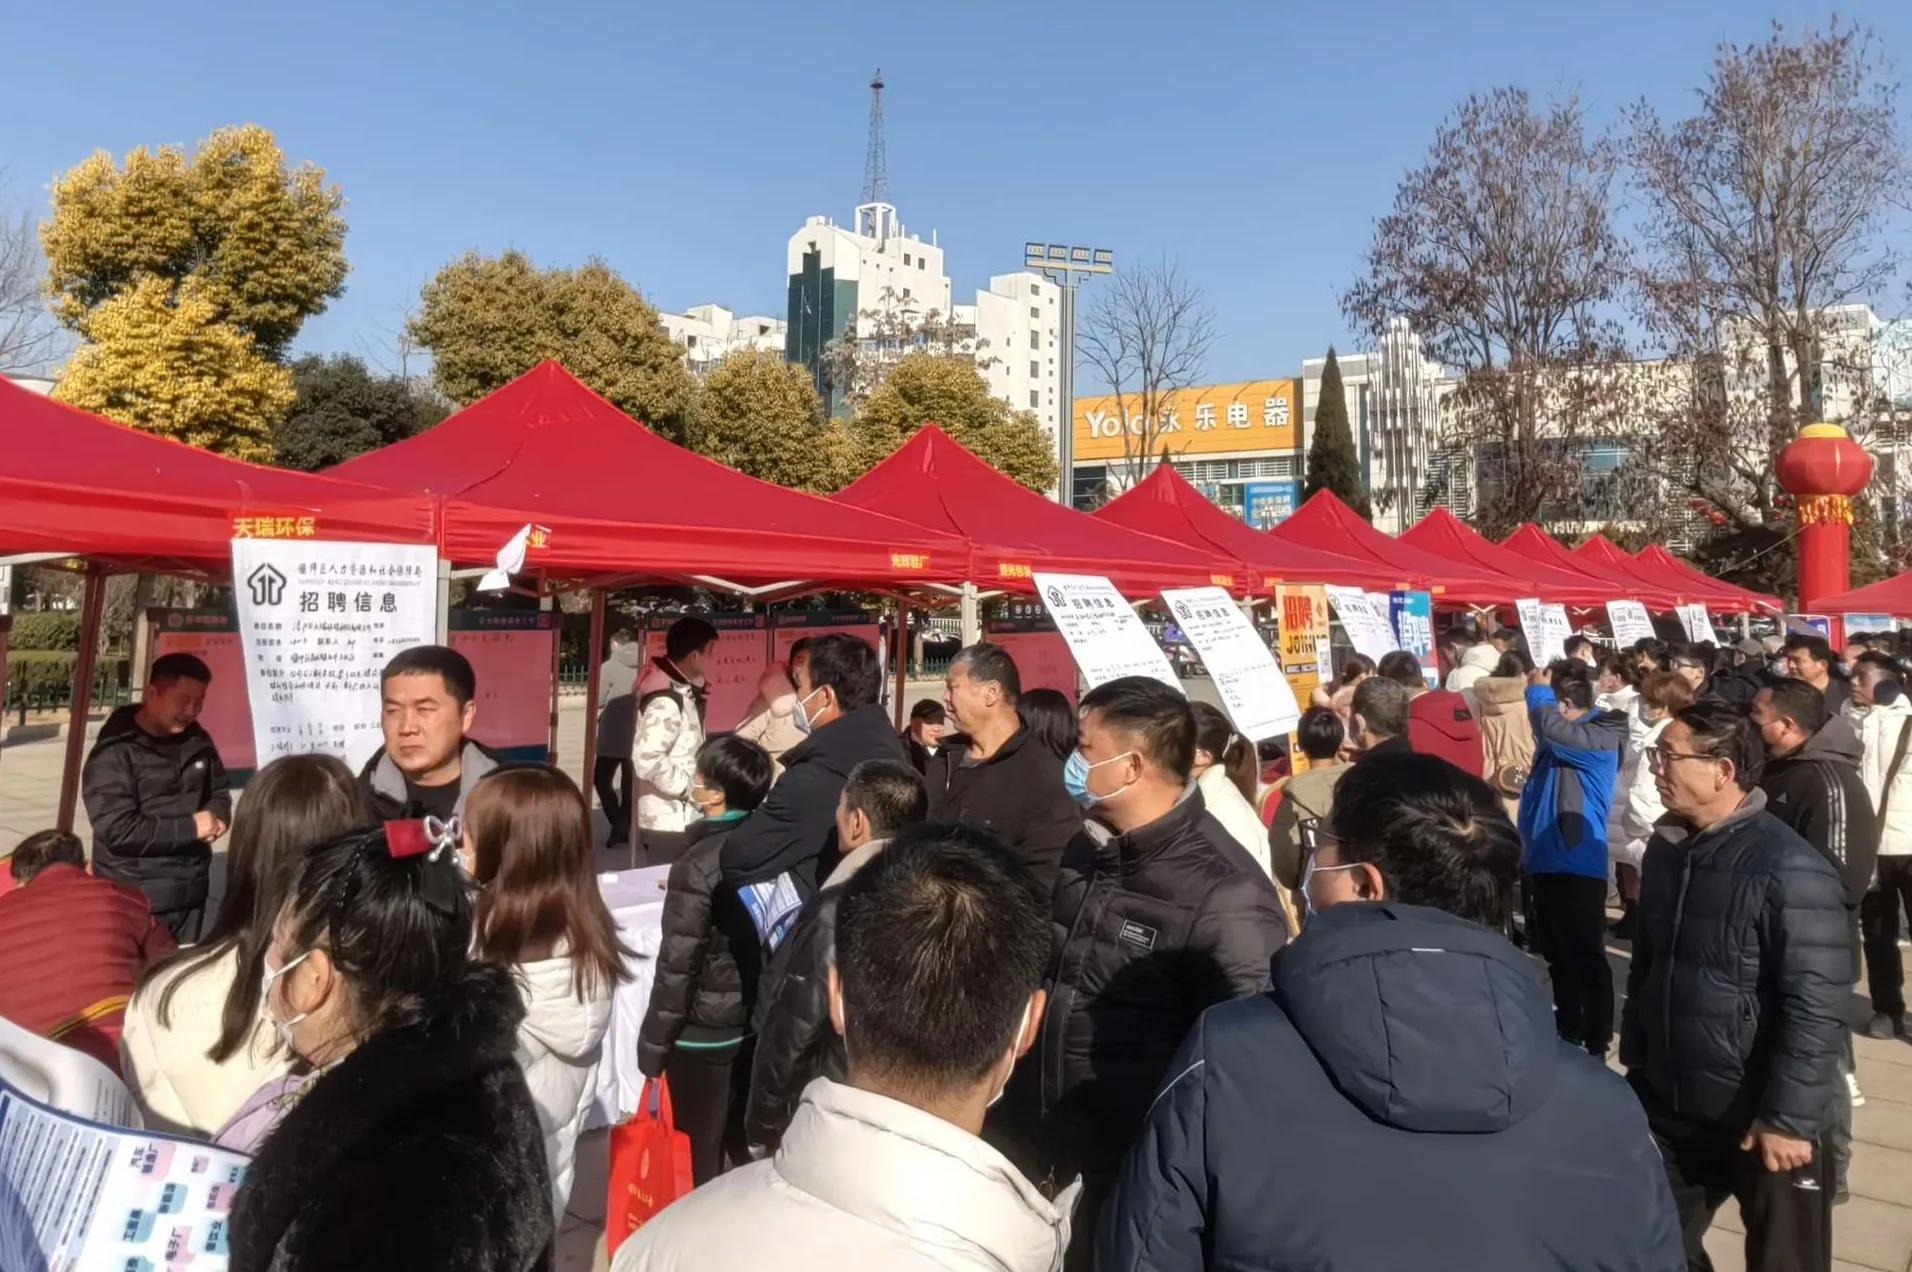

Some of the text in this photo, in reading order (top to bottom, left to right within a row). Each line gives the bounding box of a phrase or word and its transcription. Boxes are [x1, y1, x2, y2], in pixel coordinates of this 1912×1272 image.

[1159, 397, 1289, 433] 永乐电器
[232, 516, 315, 538] 天瑞环保
[299, 590, 397, 613] 招聘信息
